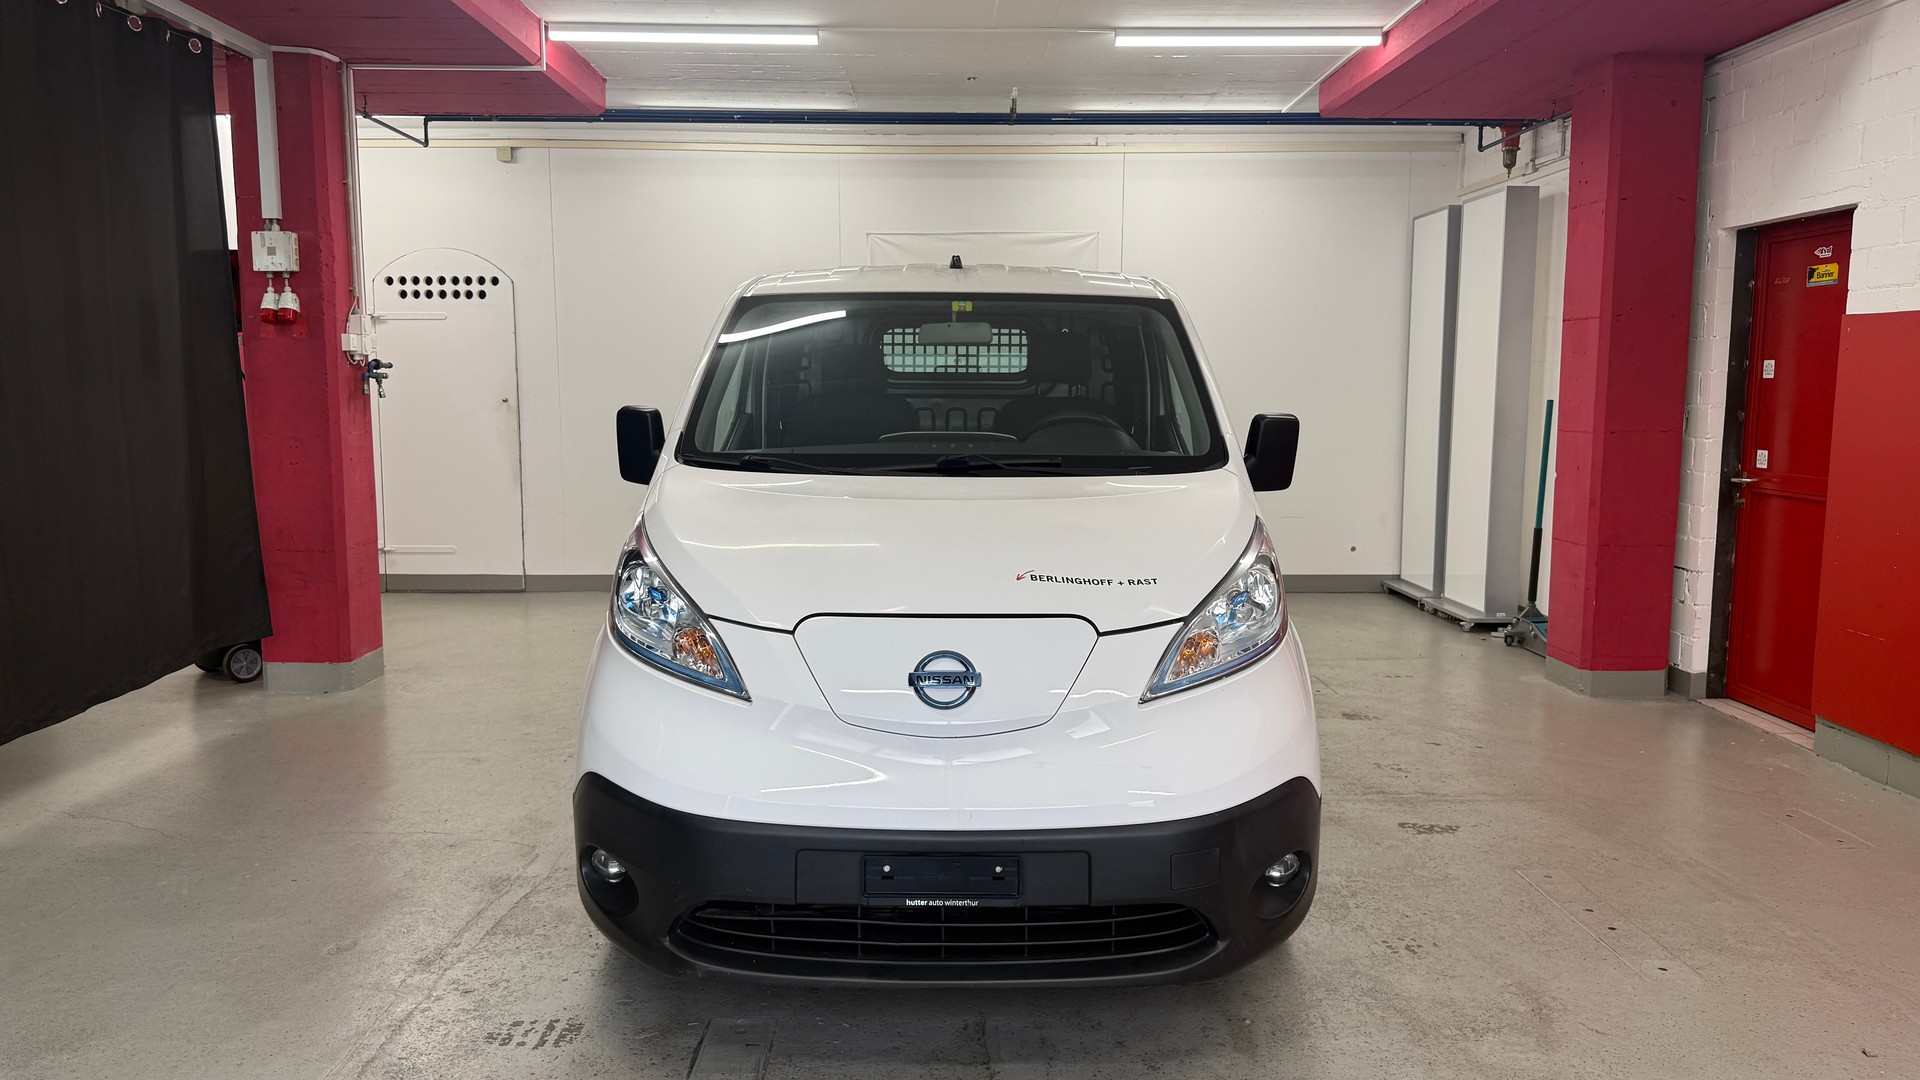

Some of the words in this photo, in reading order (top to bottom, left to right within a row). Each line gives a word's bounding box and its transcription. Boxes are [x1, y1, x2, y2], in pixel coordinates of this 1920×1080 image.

[1816, 271, 1835, 279] Banner
[1030, 574, 1114, 586] BERLINGHOFF
[1127, 578, 1158, 586] RAST
[916, 675, 974, 685] NISSAN
[906, 898, 928, 906] hutter
[944, 898, 979, 906] winterthur
